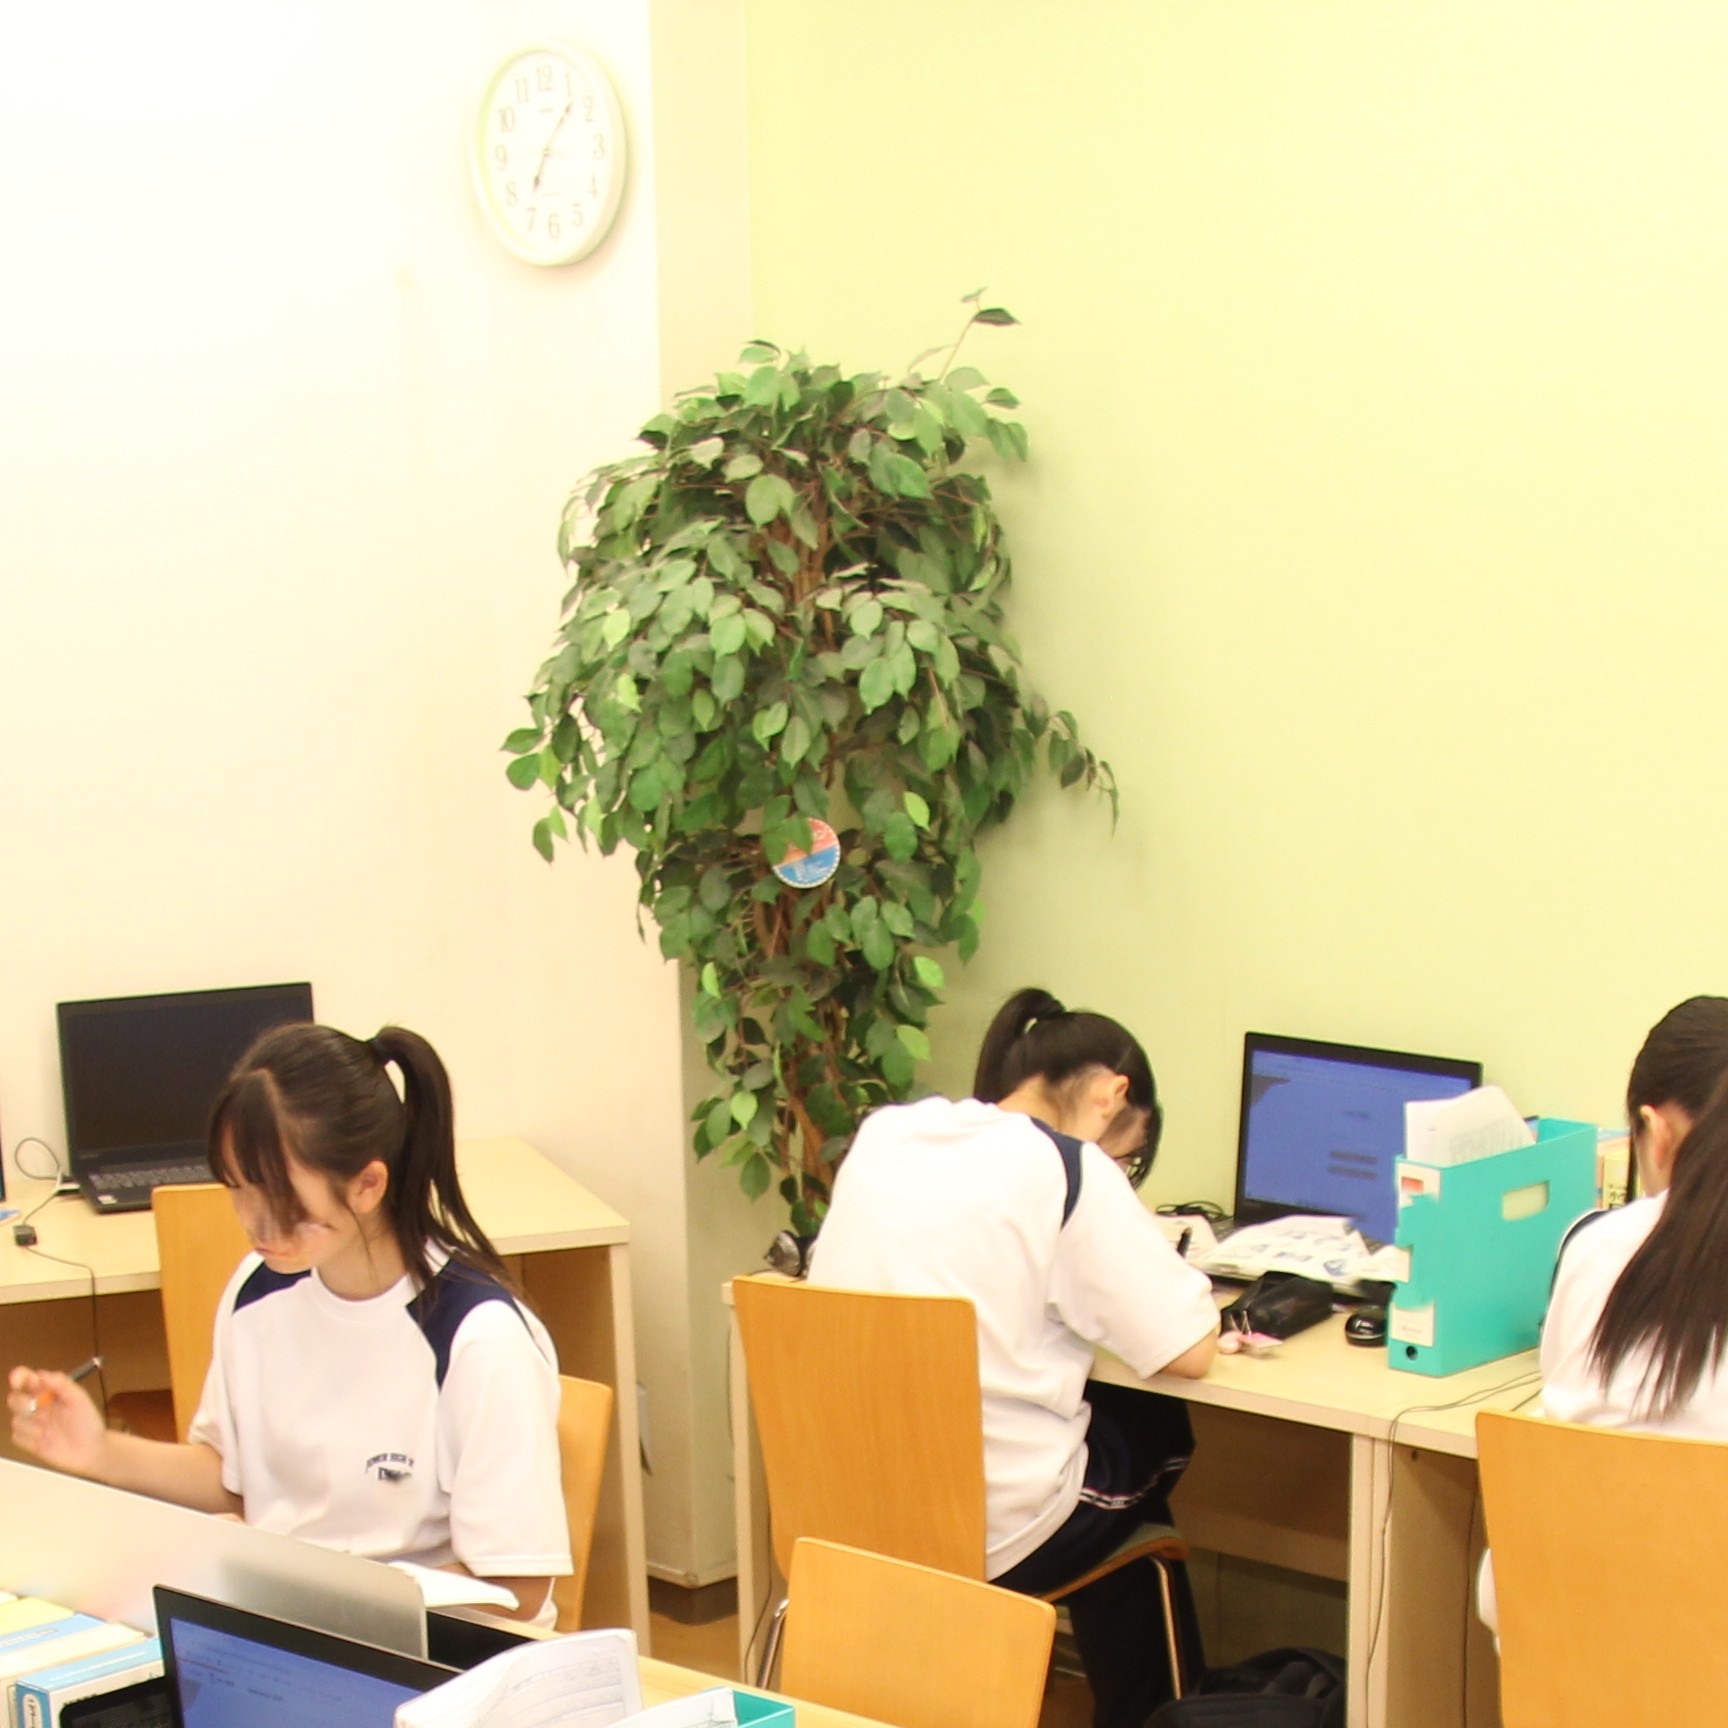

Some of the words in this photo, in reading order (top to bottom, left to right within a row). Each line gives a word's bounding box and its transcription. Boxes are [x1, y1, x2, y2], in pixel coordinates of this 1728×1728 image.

[514, 76, 530, 104] 11
[536, 64, 553, 92] 12
[565, 72, 572, 98] 1
[499, 106, 516, 133] 10
[583, 95, 594, 123] 2
[495, 144, 508, 170] 9
[593, 134, 606, 161] 3
[506, 181, 518, 208] 8
[588, 175, 598, 199] 4
[526, 207, 537, 232] 7
[548, 213, 561, 240] 6
[572, 203, 584, 228] 5
